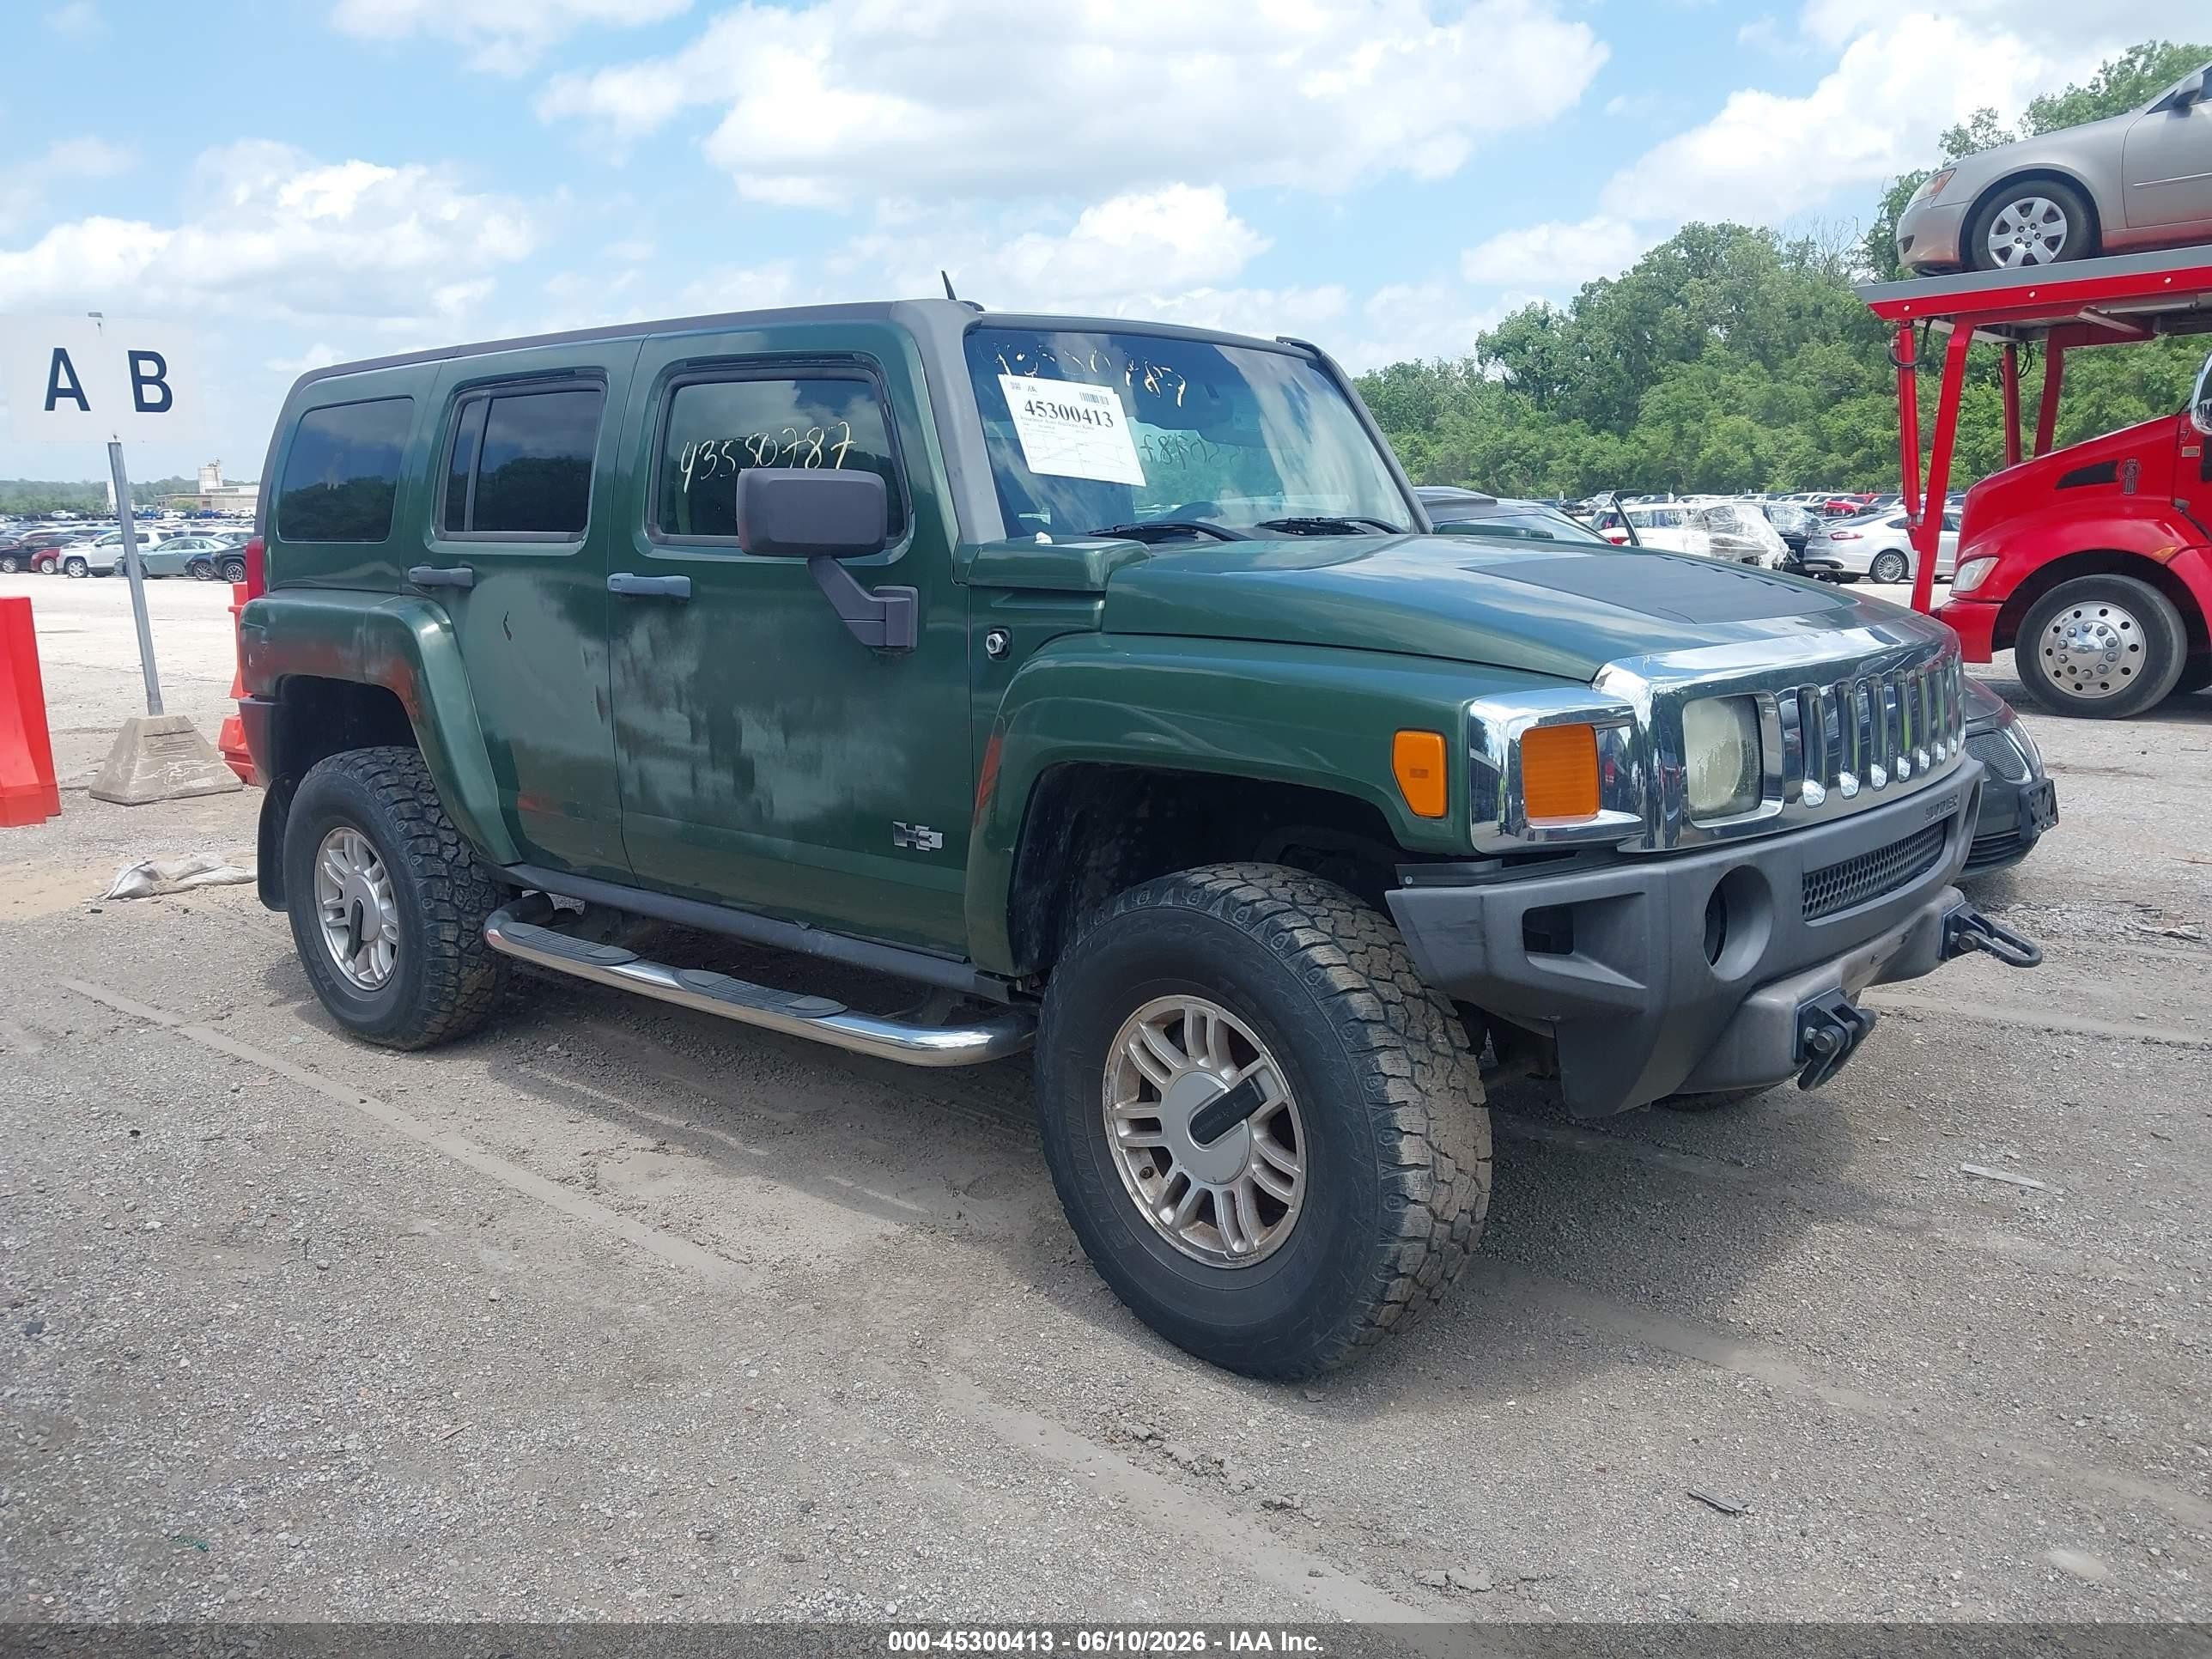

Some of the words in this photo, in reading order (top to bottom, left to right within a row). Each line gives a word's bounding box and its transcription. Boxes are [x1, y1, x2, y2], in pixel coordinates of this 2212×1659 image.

[44, 347, 91, 412] A
[127, 349, 174, 413] B
[1024, 398, 1115, 428] 45300413
[679, 421, 858, 494] 43550787
